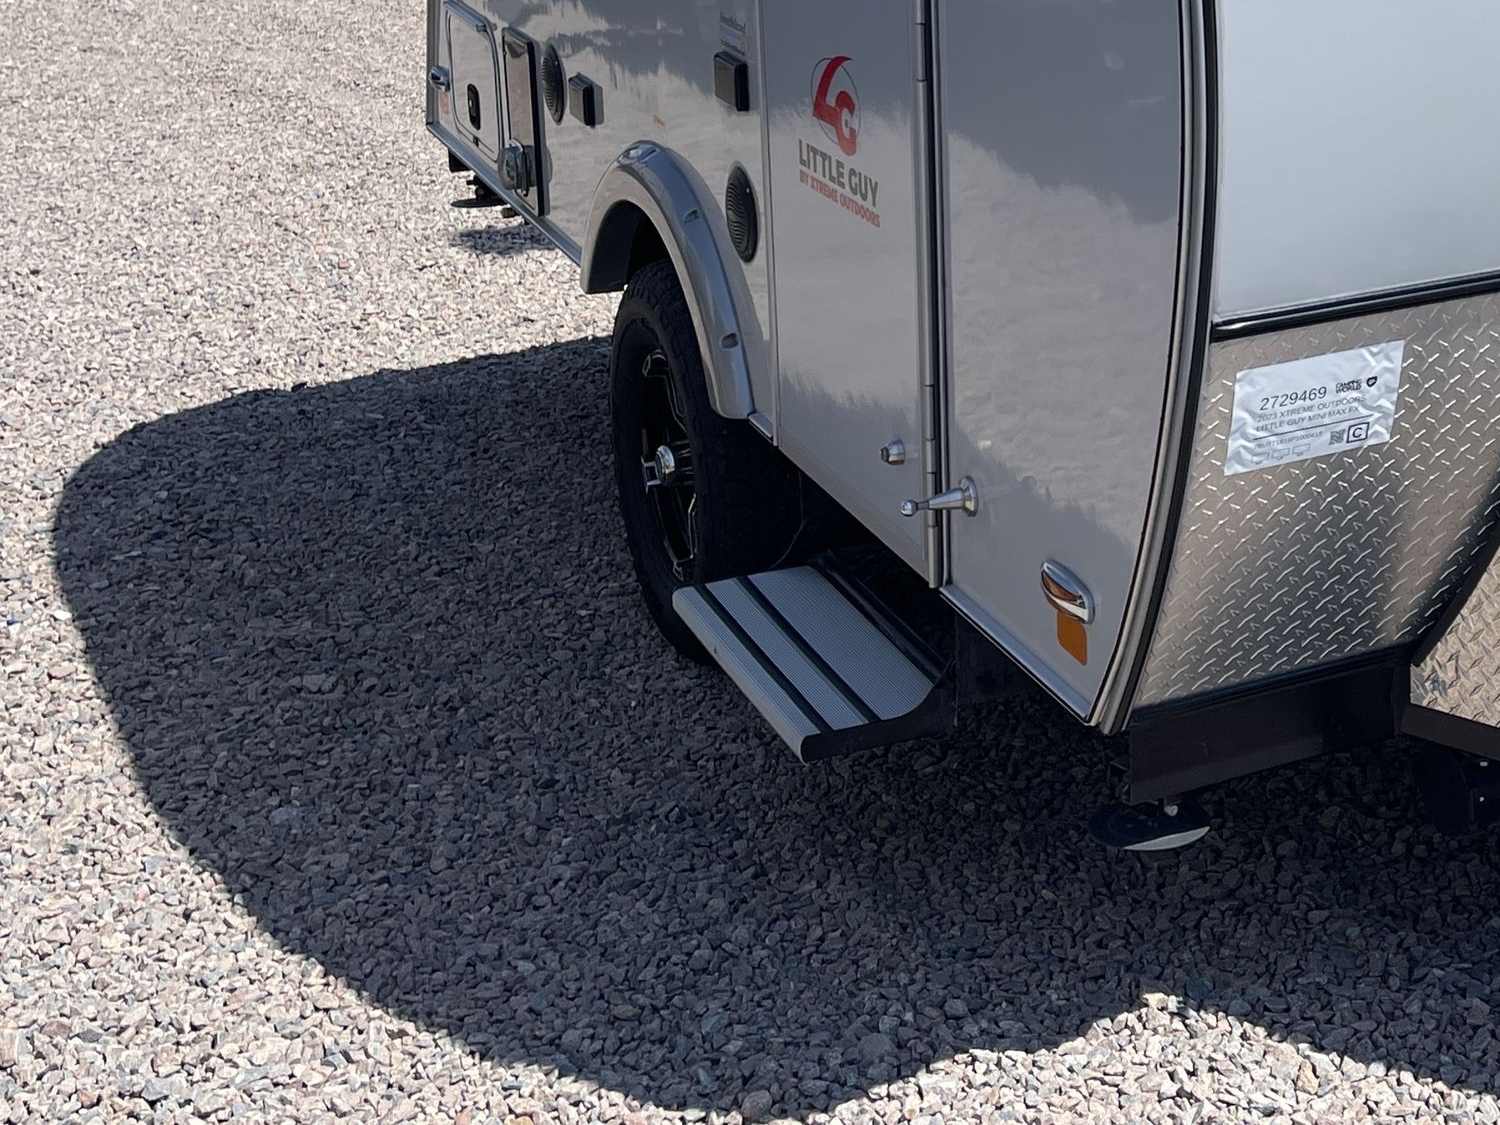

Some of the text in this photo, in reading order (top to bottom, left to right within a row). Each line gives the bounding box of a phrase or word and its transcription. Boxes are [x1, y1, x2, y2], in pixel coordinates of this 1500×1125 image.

[799, 138, 878, 207] LITTLE GUY
[799, 169, 880, 228] BY XTREME OUTDOORS
[1260, 386, 1327, 411] 2729469
[1279, 405, 1316, 417] XTREME
[1317, 395, 1367, 409] OUTDOORS
[1255, 421, 1285, 432] LITTLE
[1286, 417, 1306, 427] GUY
[1307, 413, 1327, 423] MINI
[1328, 408, 1348, 419] MAX
